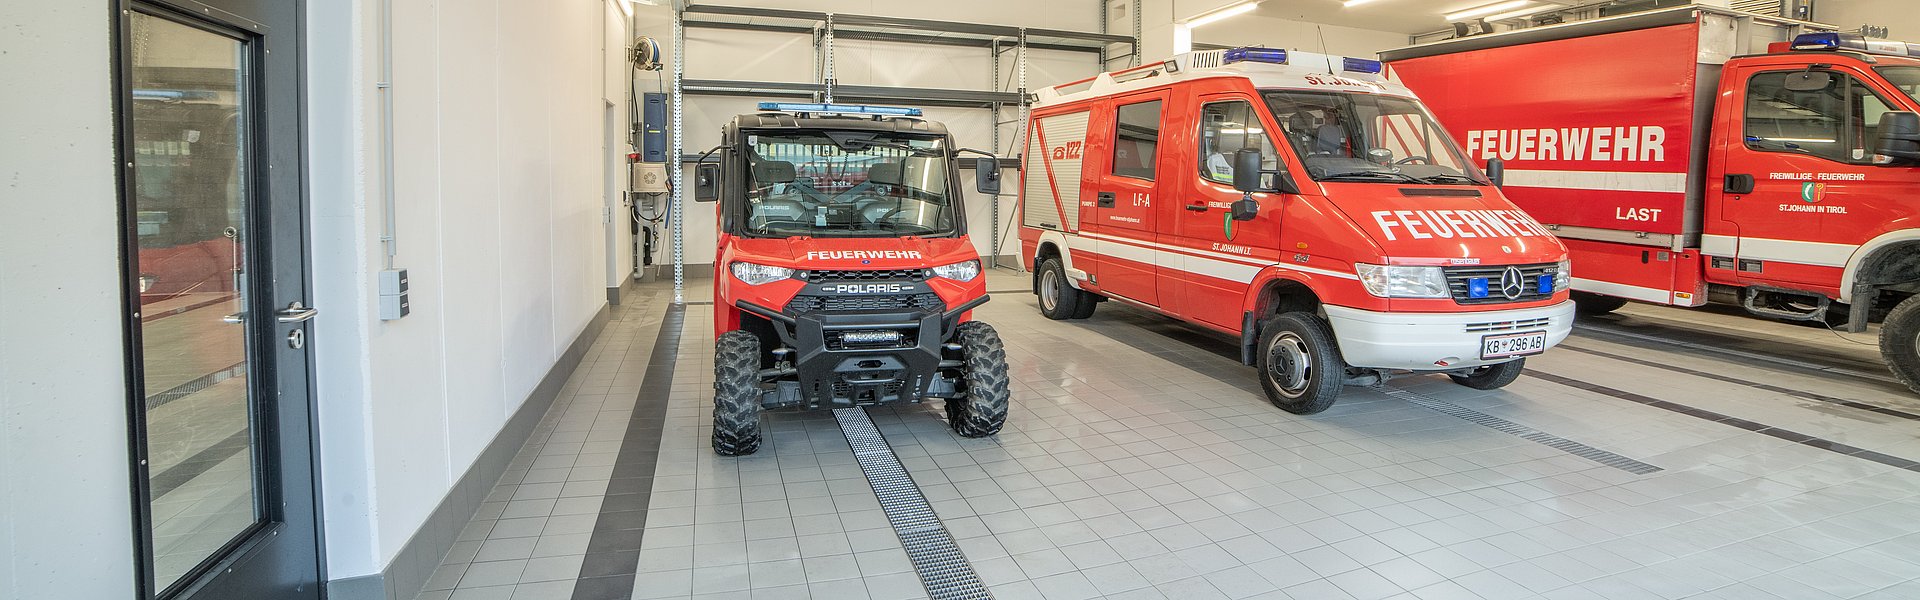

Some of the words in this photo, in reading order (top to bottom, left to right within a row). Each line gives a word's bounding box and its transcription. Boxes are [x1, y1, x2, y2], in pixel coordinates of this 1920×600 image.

[1466, 125, 1666, 162] FEUERWEHR
[1065, 141, 1082, 160] 122
[1769, 172, 1813, 180] FREIWILLIGE
[1817, 173, 1865, 181] FEUERWEHR
[1133, 192, 1151, 208] LF-A
[1208, 201, 1232, 209] FREIWILLIG
[1615, 206, 1662, 222] LAST
[1778, 203, 1816, 213] ST.JOHANN
[1817, 205, 1825, 213] IN
[1826, 206, 1848, 214] TIROL
[807, 250, 922, 260] FEUERWEHR
[1219, 243, 1245, 255] JOHANN
[836, 283, 901, 294] POLARIS
[1485, 340, 1500, 354] KB
[1509, 337, 1528, 352] 296
[1529, 336, 1542, 349] AB
